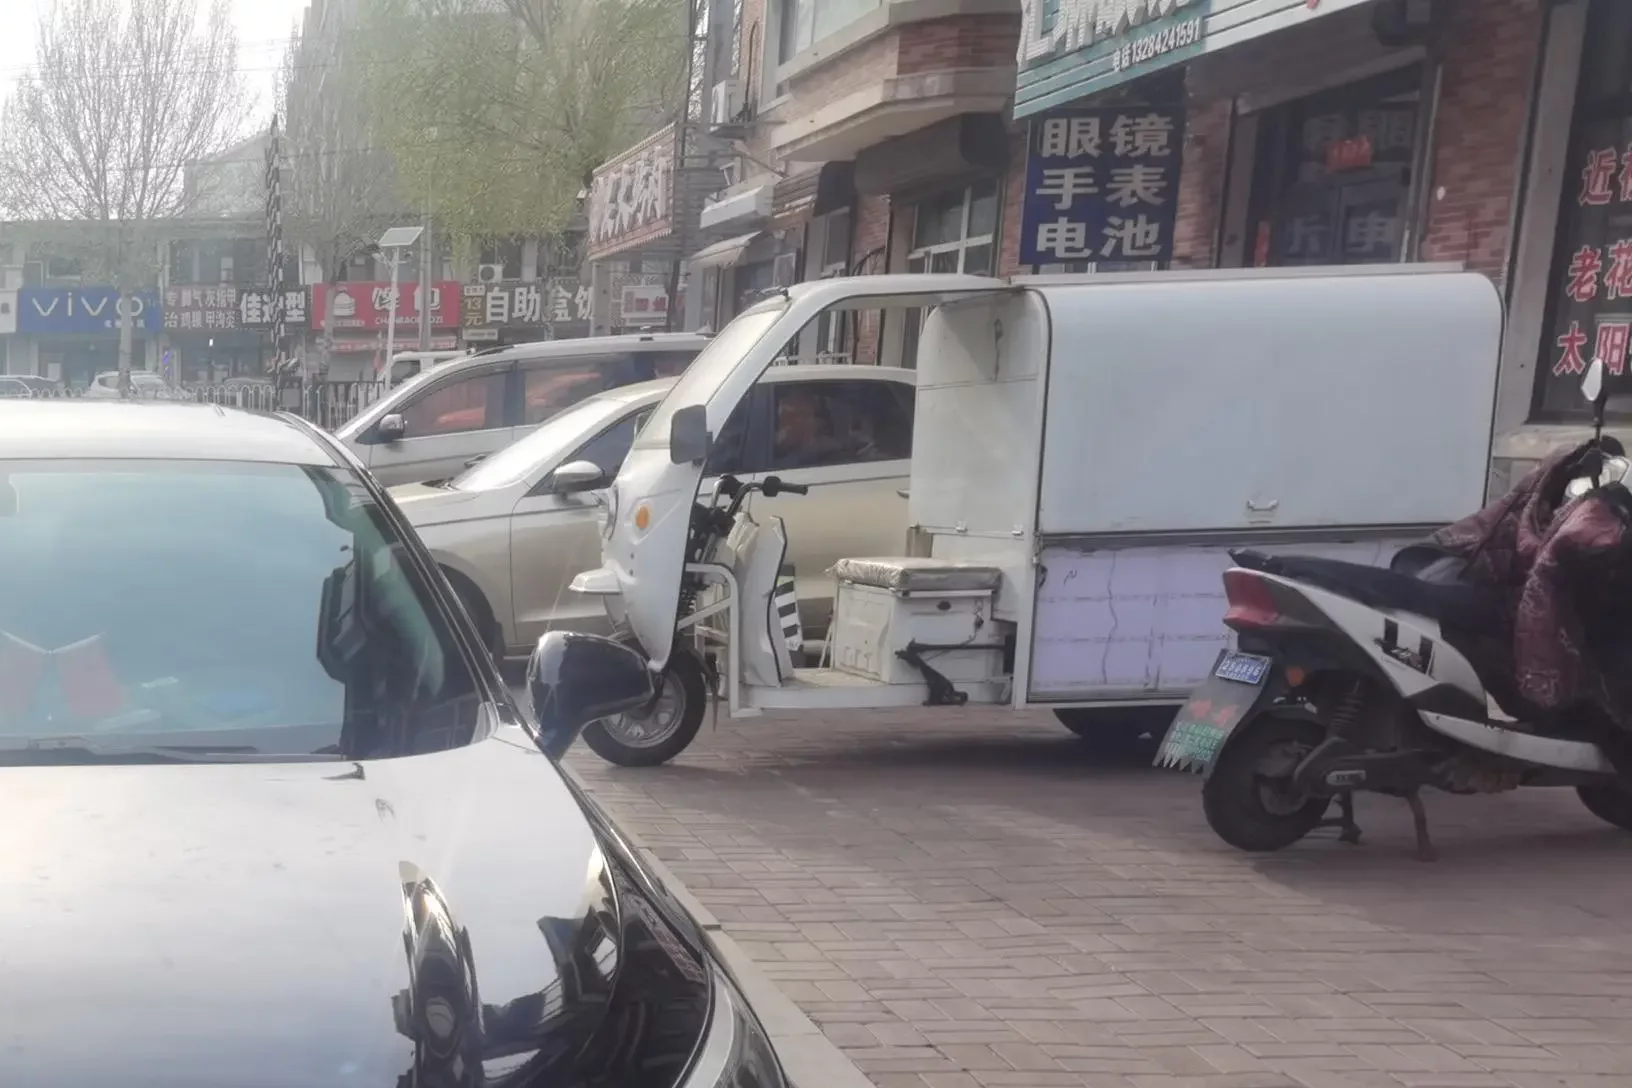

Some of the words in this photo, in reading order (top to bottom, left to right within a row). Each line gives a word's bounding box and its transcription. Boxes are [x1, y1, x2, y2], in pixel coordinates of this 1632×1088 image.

[1040, 114, 1174, 159] 眼镜
[1035, 165, 1168, 210] 手表
[1035, 216, 1162, 259] 电池
[31, 291, 144, 317] vivo
